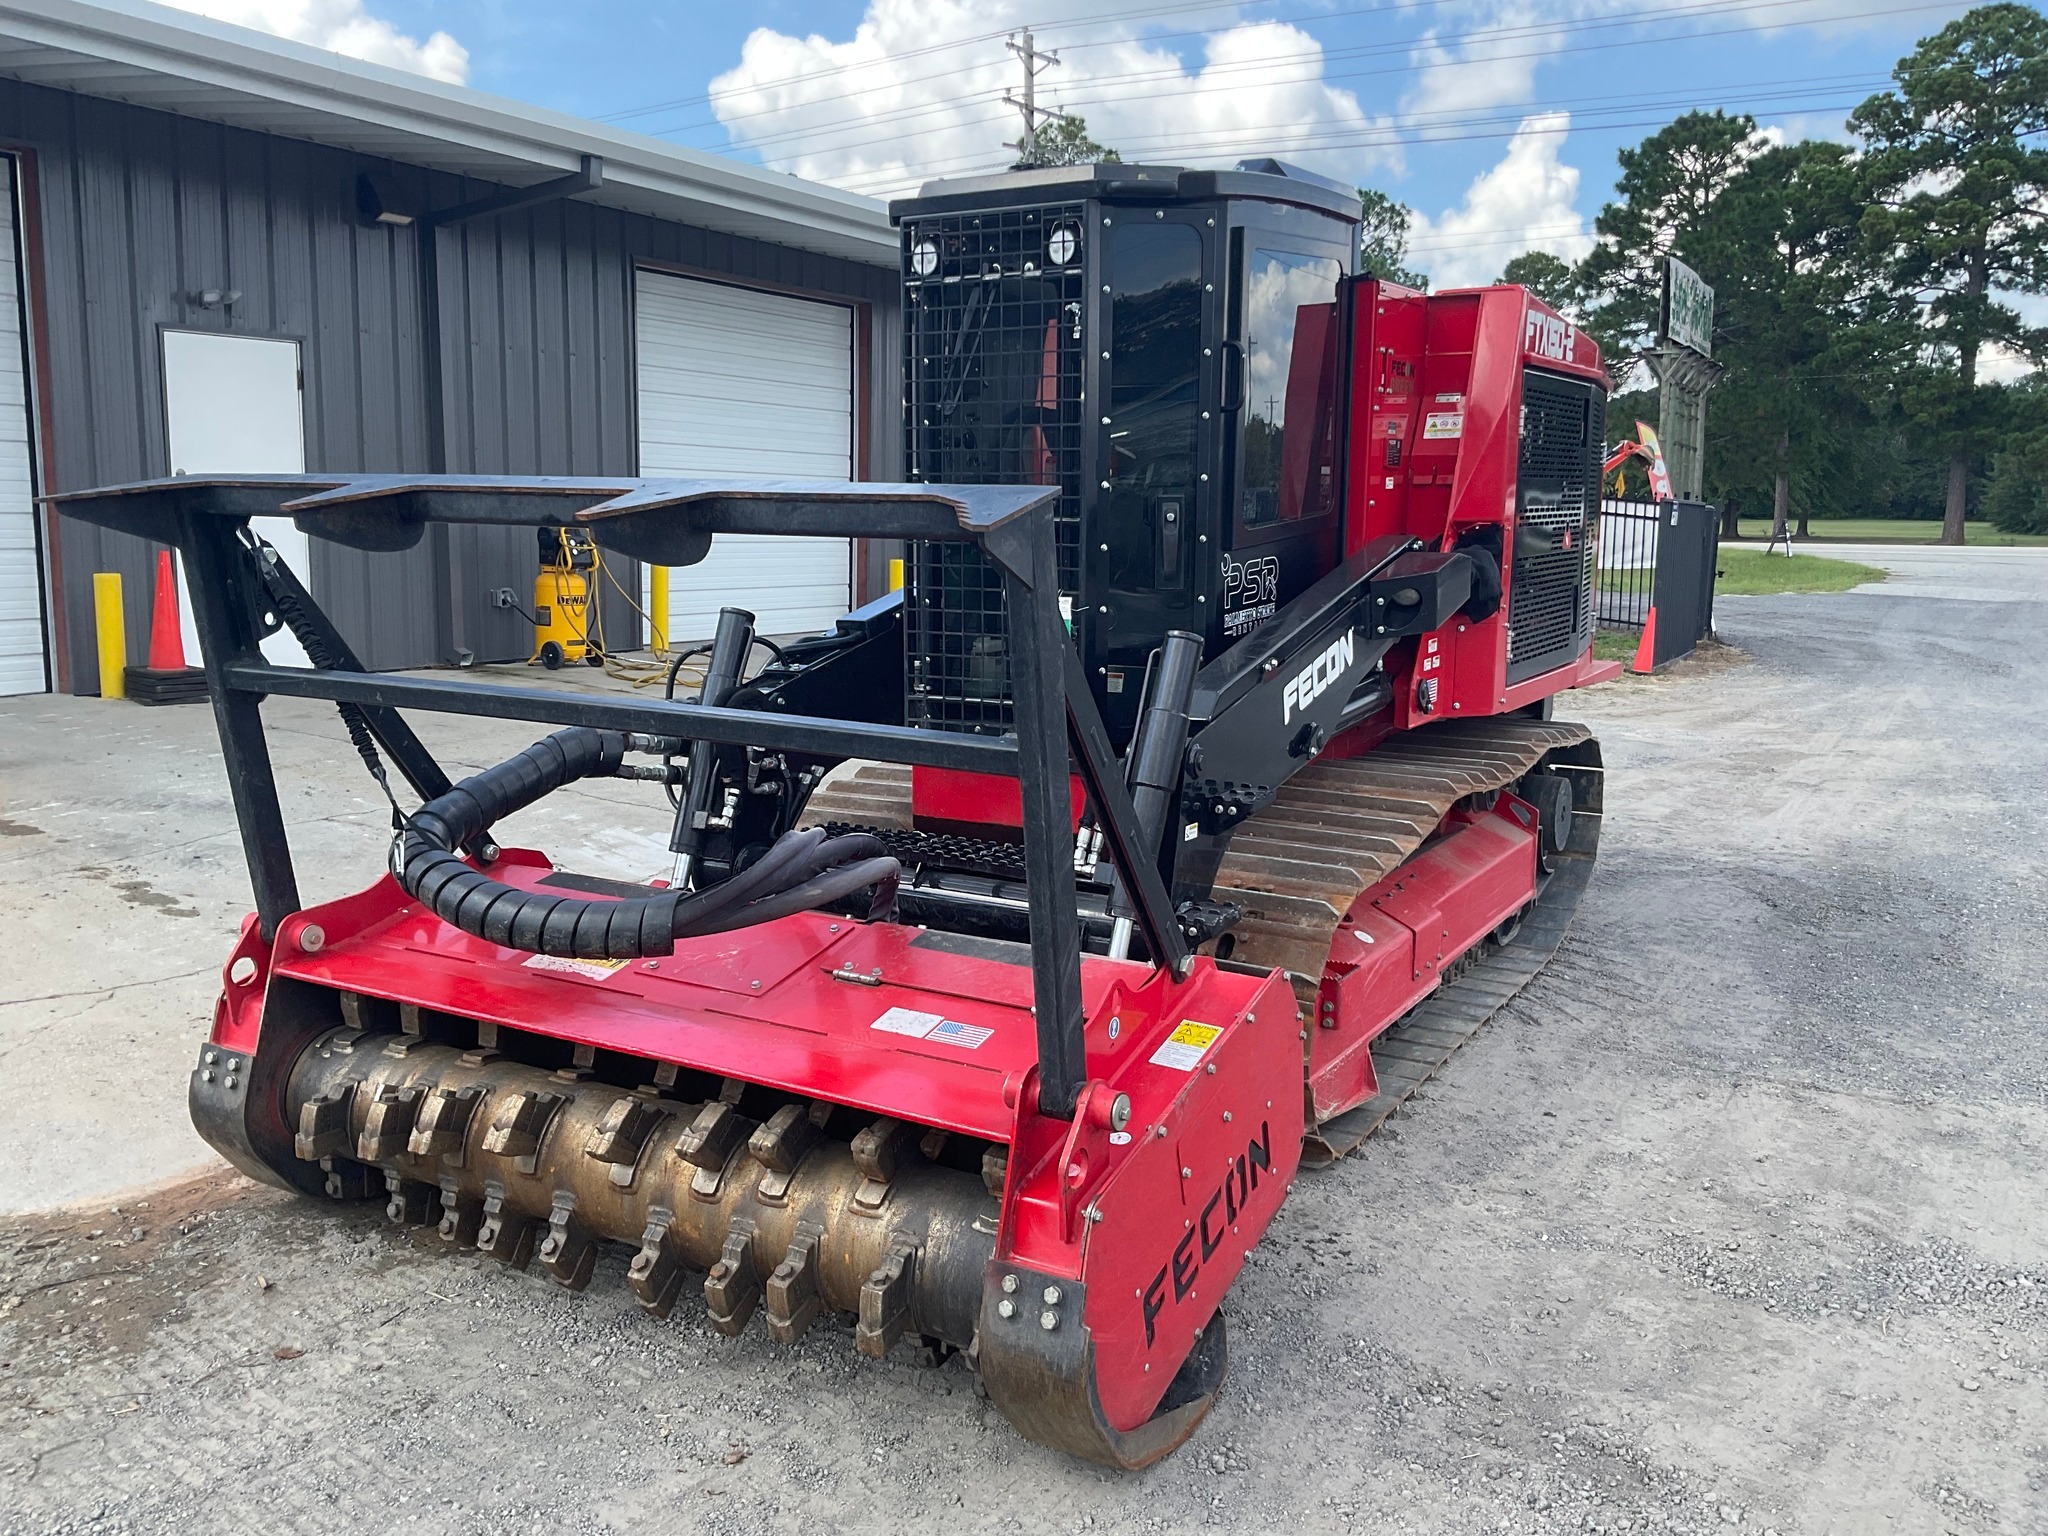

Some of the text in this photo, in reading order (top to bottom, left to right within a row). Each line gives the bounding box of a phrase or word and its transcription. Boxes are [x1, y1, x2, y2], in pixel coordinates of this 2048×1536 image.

[1525, 309, 1575, 362] FTX150-2
[557, 596, 586, 605] DEWAL
[1223, 556, 1279, 609] PSR
[1224, 602, 1276, 628] PALMETTO STATE
[1232, 619, 1267, 637] RENTA
[1283, 628, 1354, 726] FECON
[1190, 1022, 1219, 1032] CAUTION
[1143, 1121, 1271, 1350] FECON
